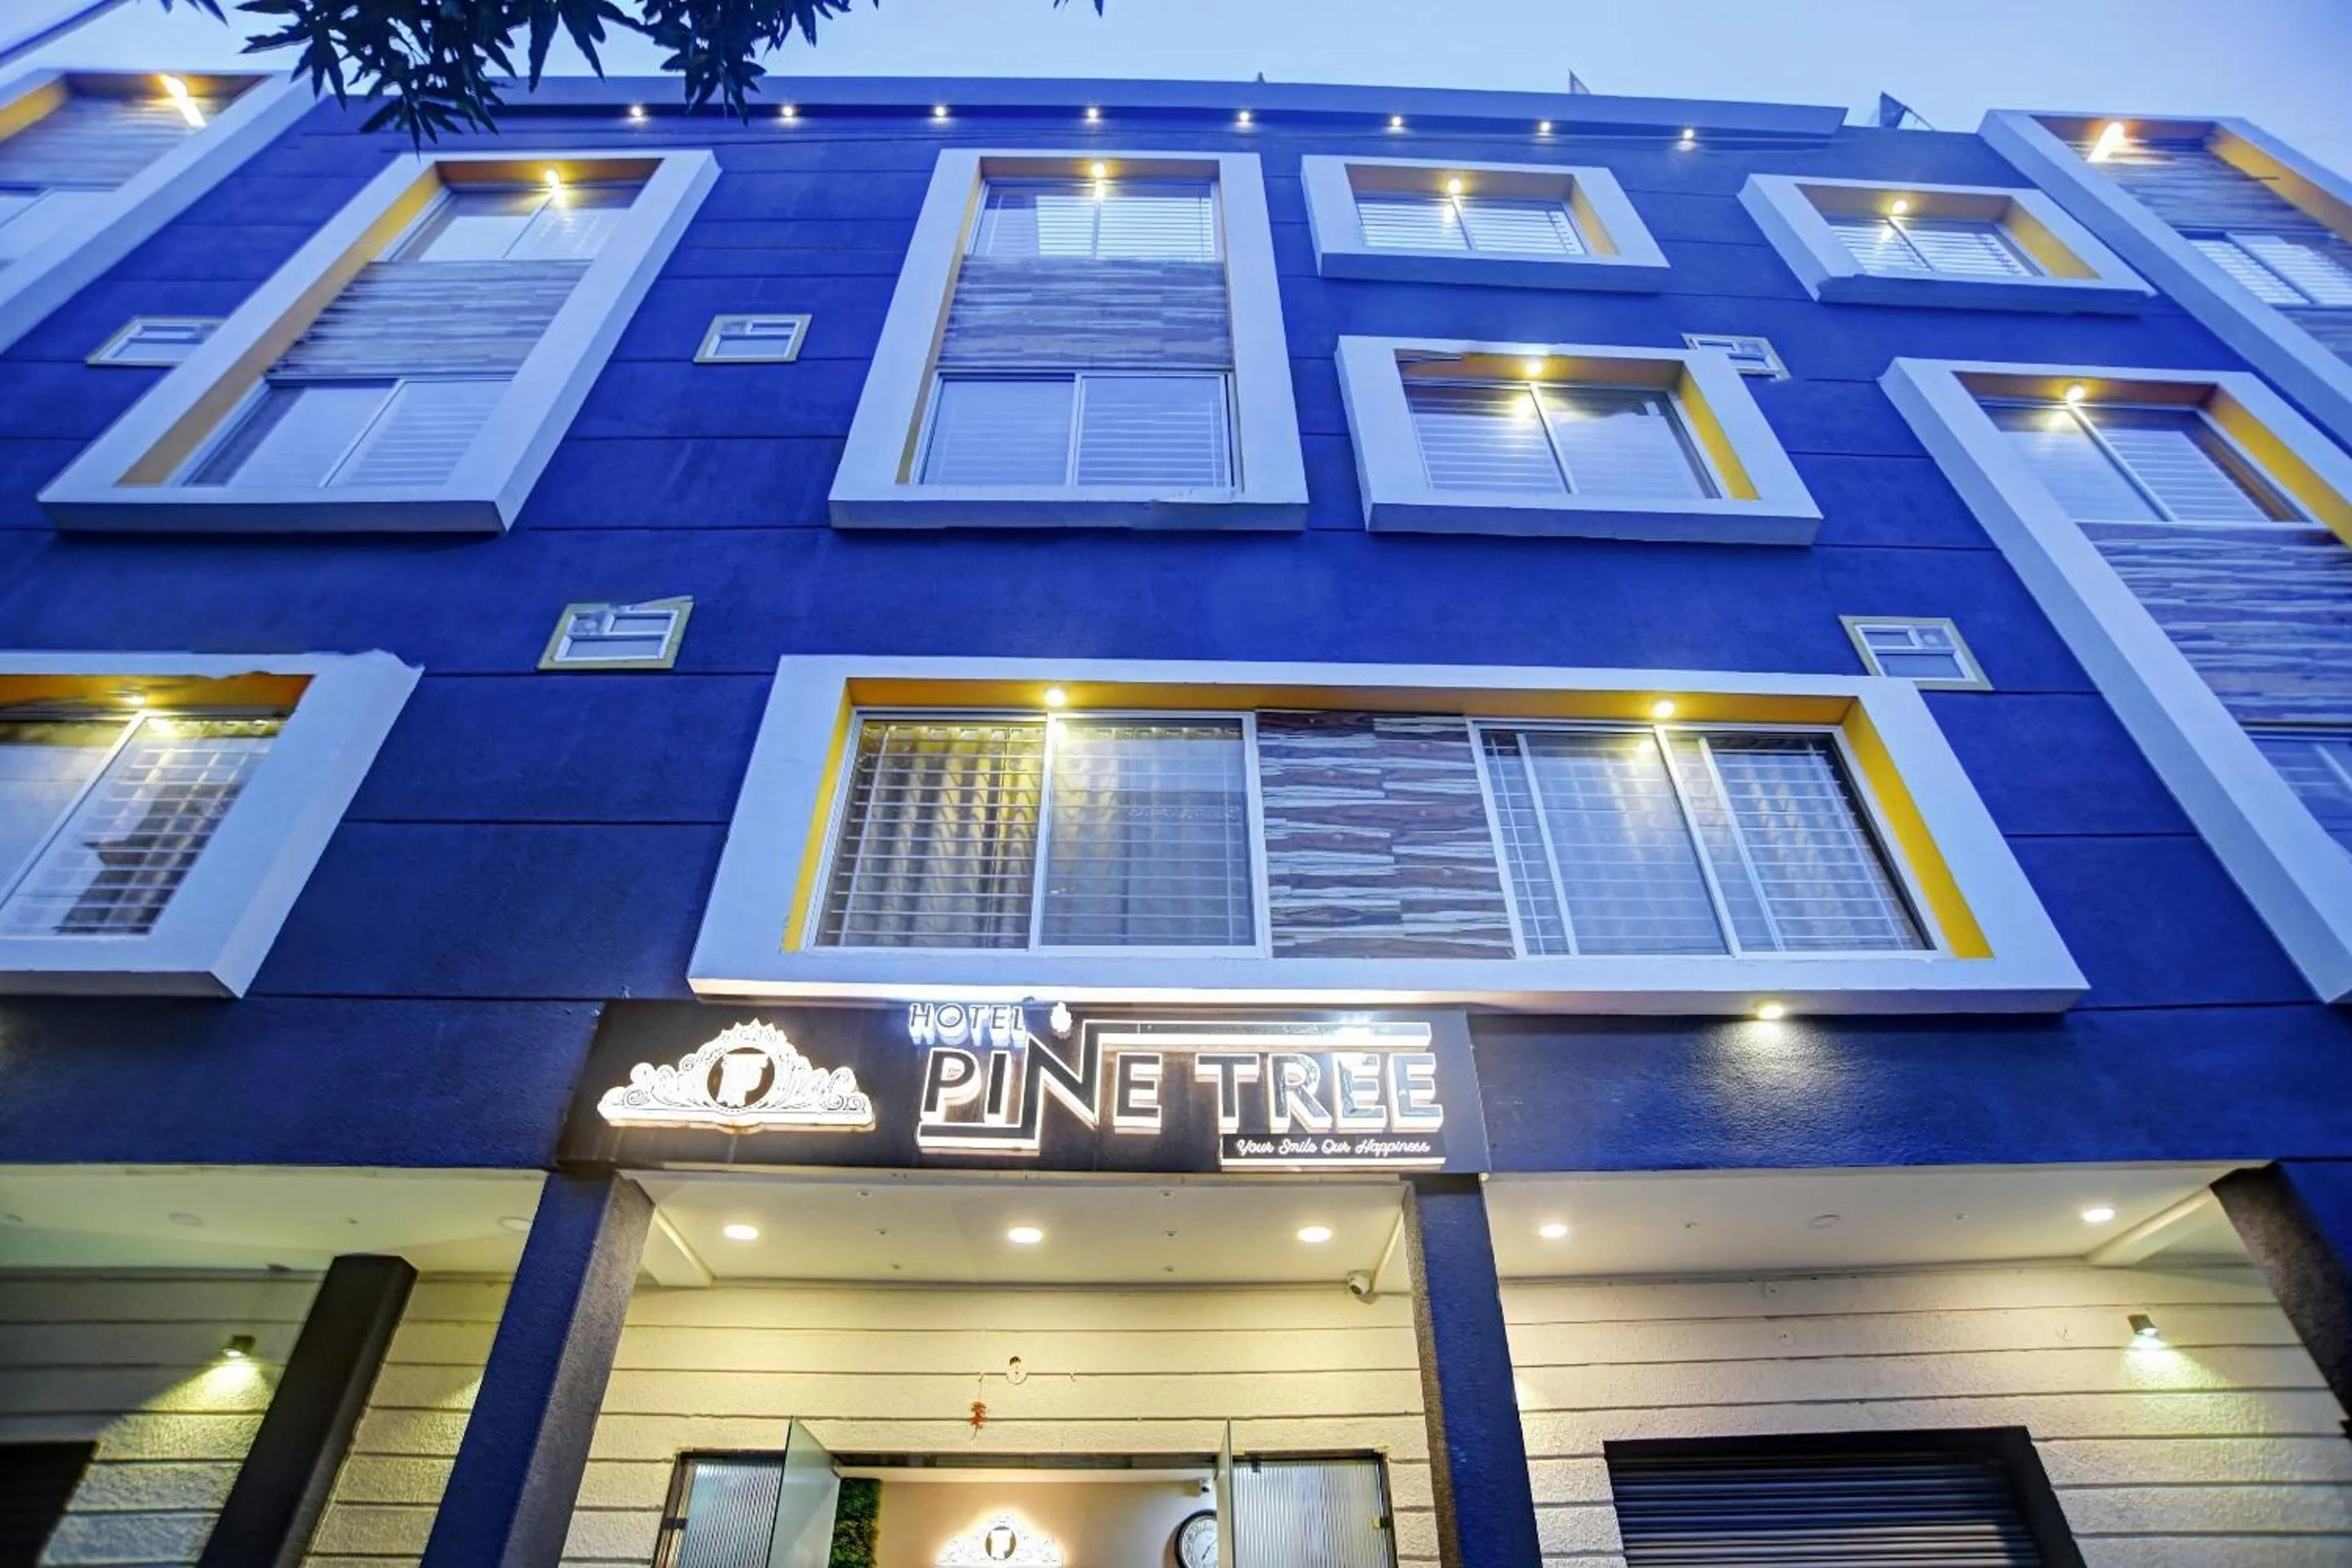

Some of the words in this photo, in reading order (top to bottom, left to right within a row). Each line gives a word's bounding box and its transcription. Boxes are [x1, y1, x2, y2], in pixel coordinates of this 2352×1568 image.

[908, 1003, 1026, 1046] HOTEL
[917, 1019, 1163, 1156] PINE
[1195, 1052, 1444, 1133] TREE
[1236, 1138, 1274, 1156] Your
[1278, 1138, 1318, 1156] Smile
[1321, 1139, 1352, 1156] Our
[1355, 1138, 1432, 1158] Happiness
